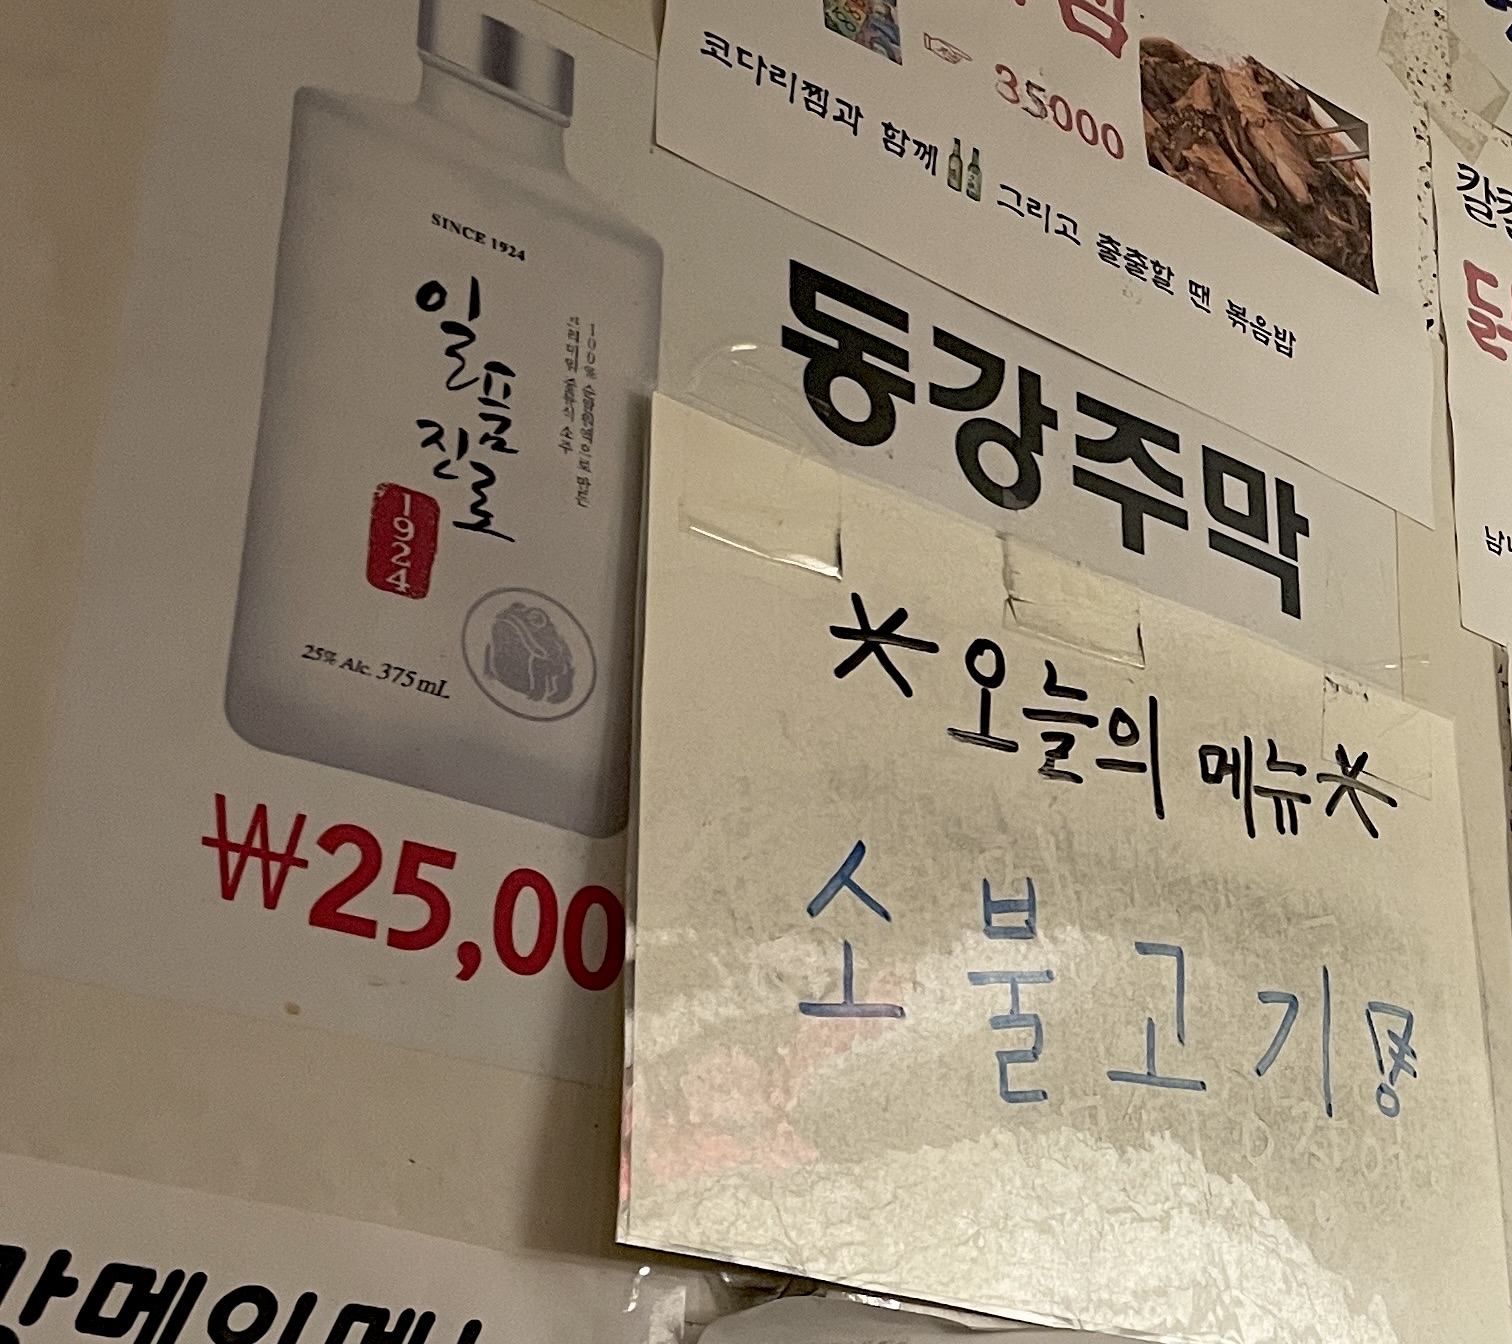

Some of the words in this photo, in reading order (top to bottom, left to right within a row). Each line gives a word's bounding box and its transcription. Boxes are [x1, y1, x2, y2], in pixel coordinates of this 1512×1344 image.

[994, 62, 1124, 161] 35000
[431, 212, 485, 245] SINCE
[491, 236, 526, 261] 1924
[699, 31, 864, 136] 코다리찜과
[881, 119, 939, 176] 함께
[996, 182, 1081, 246] 그리고
[1096, 233, 1175, 296] 출출할
[1188, 278, 1212, 314] 땐
[1225, 299, 1297, 359] 볶음밥
[781, 259, 1310, 620] 동강주막
[385, 492, 415, 594] 1924
[301, 643, 337, 665] 25%
[946, 637, 1165, 819] 오늘의
[1199, 735, 1311, 839] 메뉴
